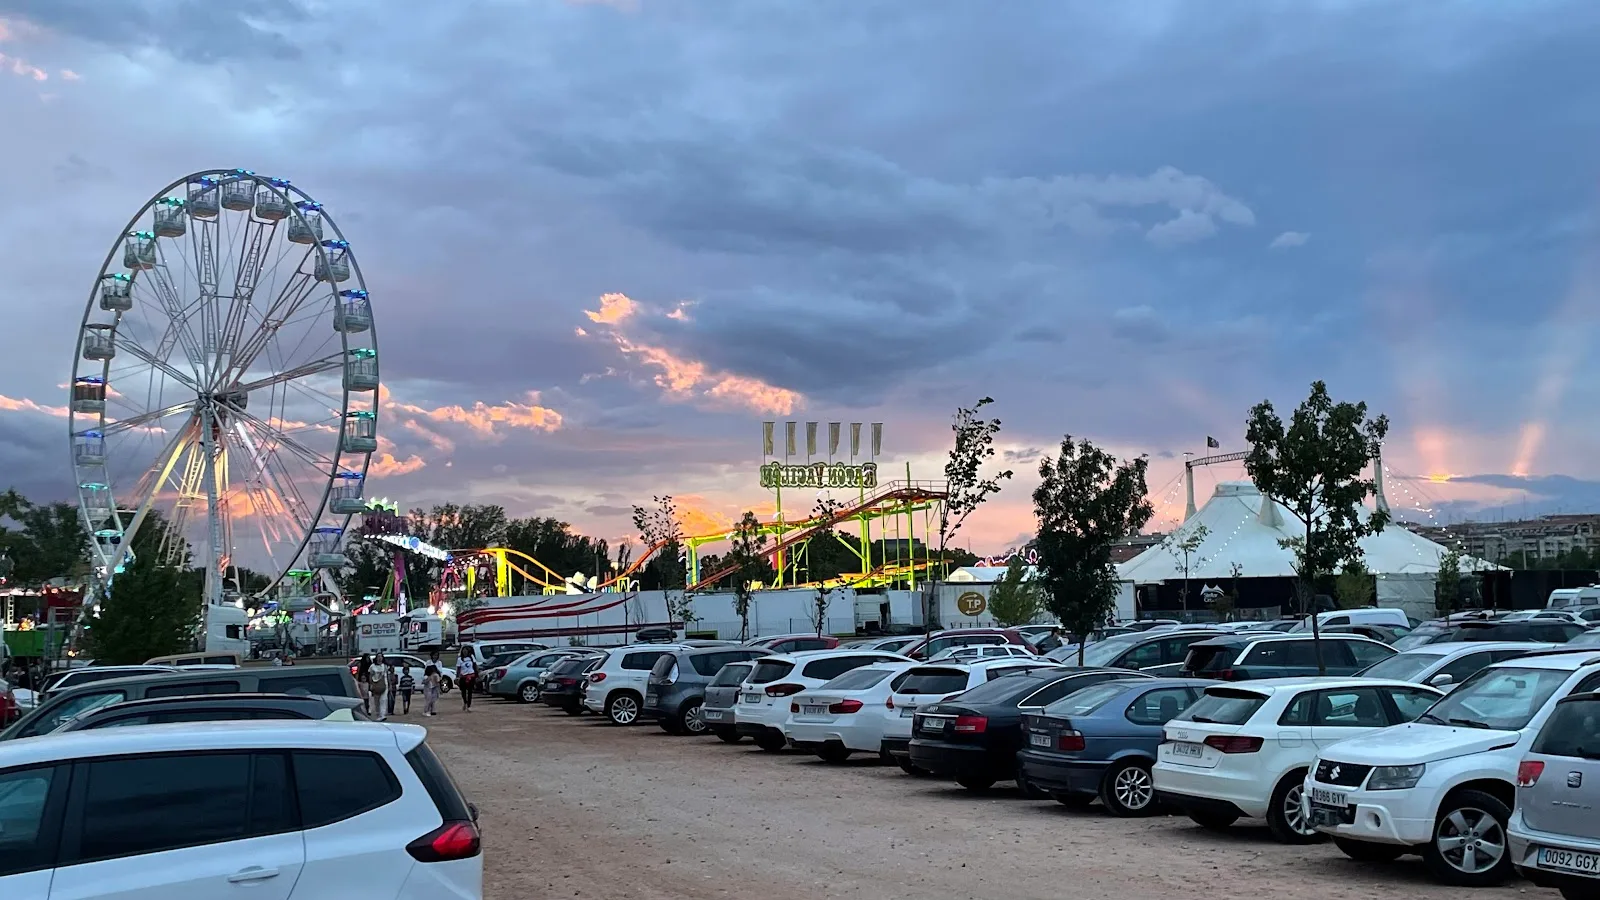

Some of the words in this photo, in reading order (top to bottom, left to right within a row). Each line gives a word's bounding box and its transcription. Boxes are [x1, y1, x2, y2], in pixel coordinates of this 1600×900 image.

[1331, 792, 1346, 805] GYY
[1545, 849, 1573, 867] 0092
[1575, 852, 1599, 871] GGX
